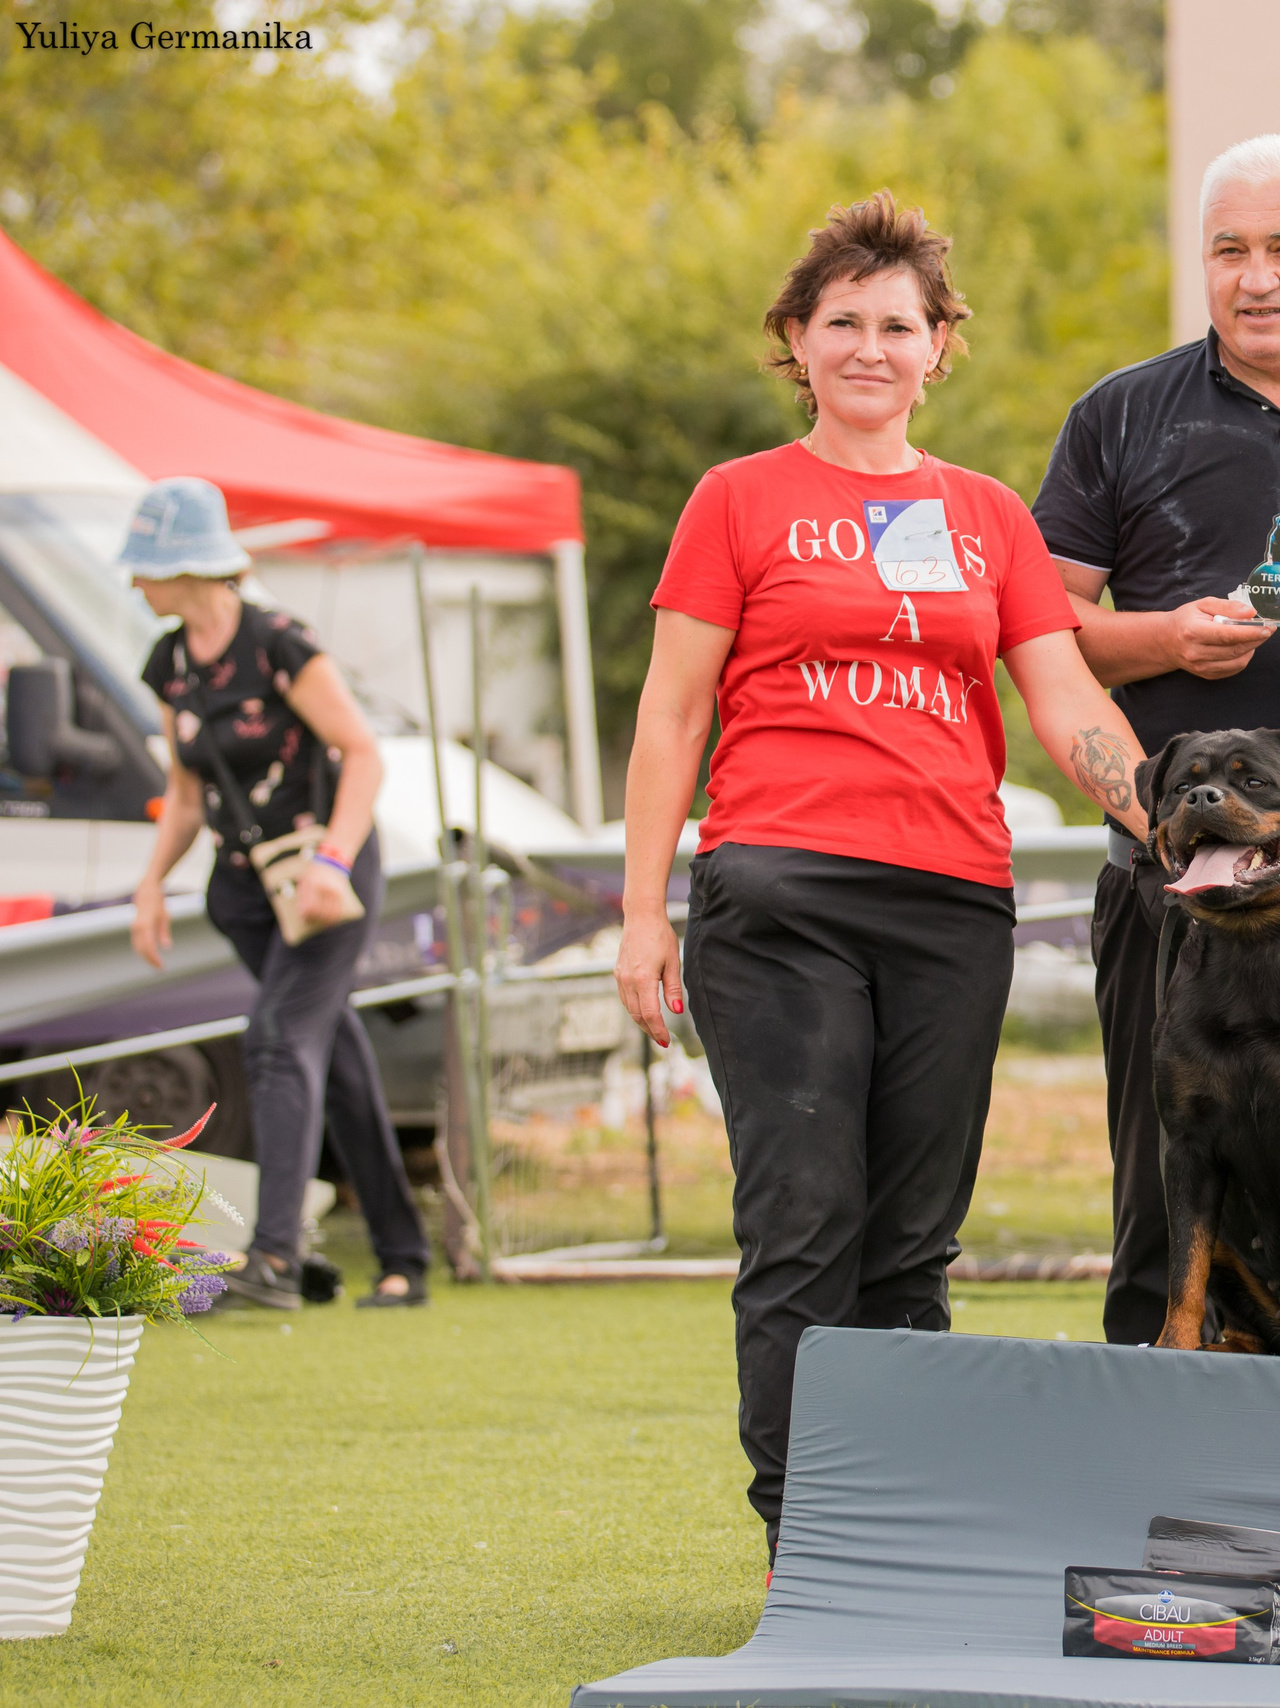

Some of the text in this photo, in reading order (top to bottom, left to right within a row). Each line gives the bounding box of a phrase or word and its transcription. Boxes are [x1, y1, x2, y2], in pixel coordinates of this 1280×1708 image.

[788, 518, 986, 577] GO S
[895, 556, 946, 585] 63
[879, 594, 924, 643] A
[798, 660, 983, 724] WOMAN
[1140, 1604, 1190, 1623] CIBAU
[1132, 1646, 1170, 1655] MAINTENANCE
[1144, 1629, 1184, 1643] ADULT
